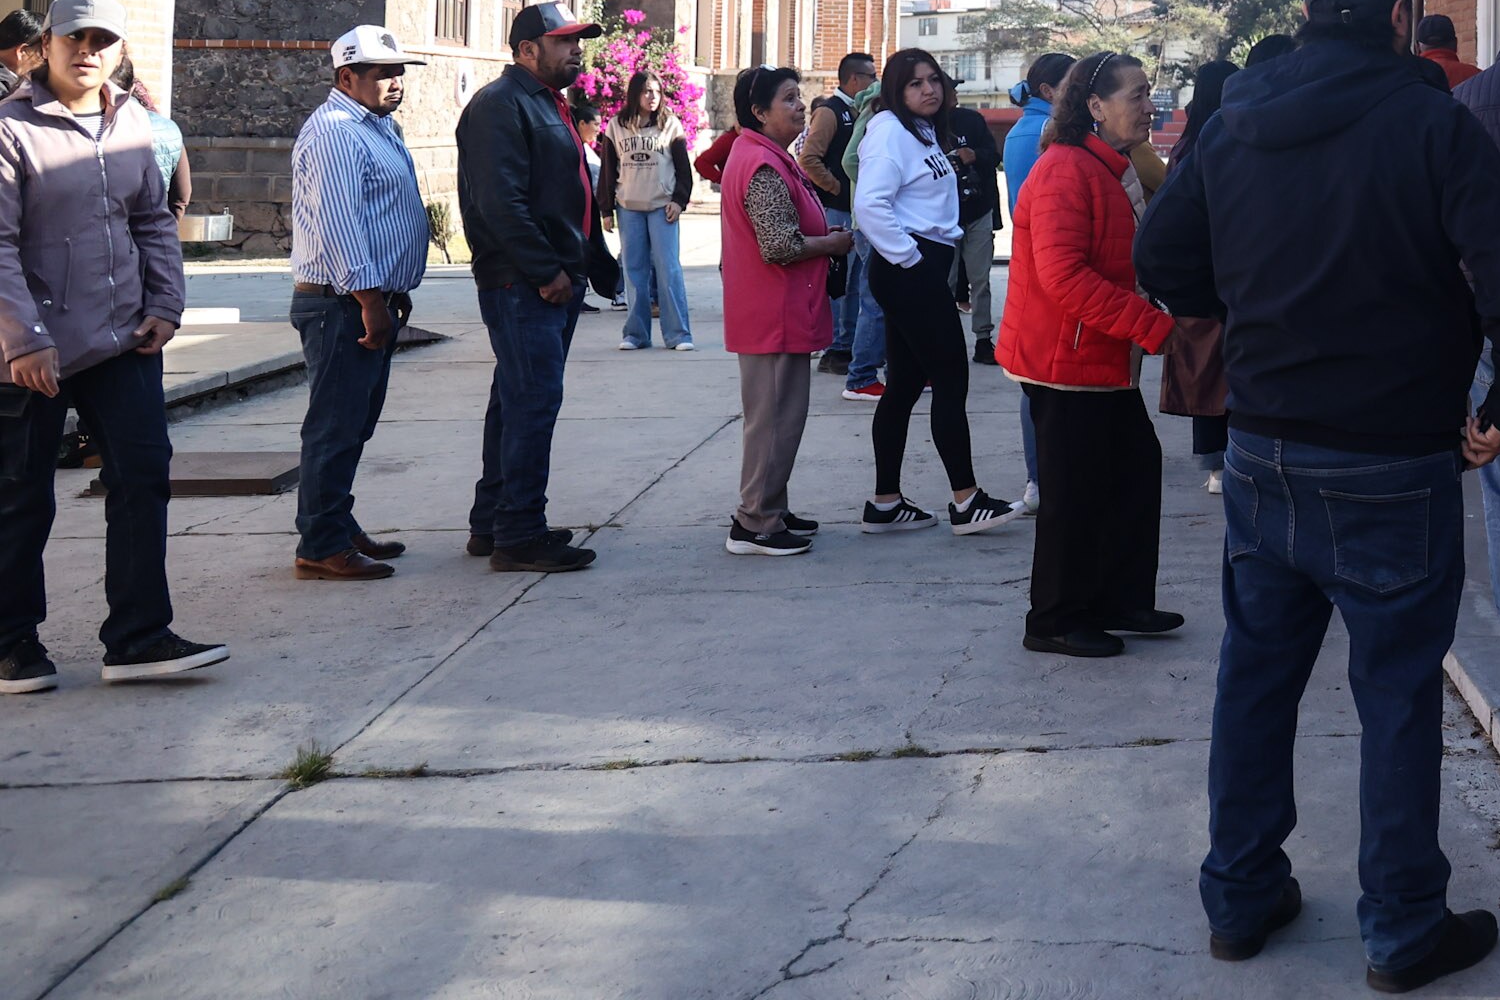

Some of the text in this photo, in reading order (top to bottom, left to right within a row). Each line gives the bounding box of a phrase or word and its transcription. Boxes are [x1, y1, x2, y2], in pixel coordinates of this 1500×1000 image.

[842, 110, 851, 121] M
[619, 136, 664, 155] NEW YORK
[634, 153, 647, 161] USA
